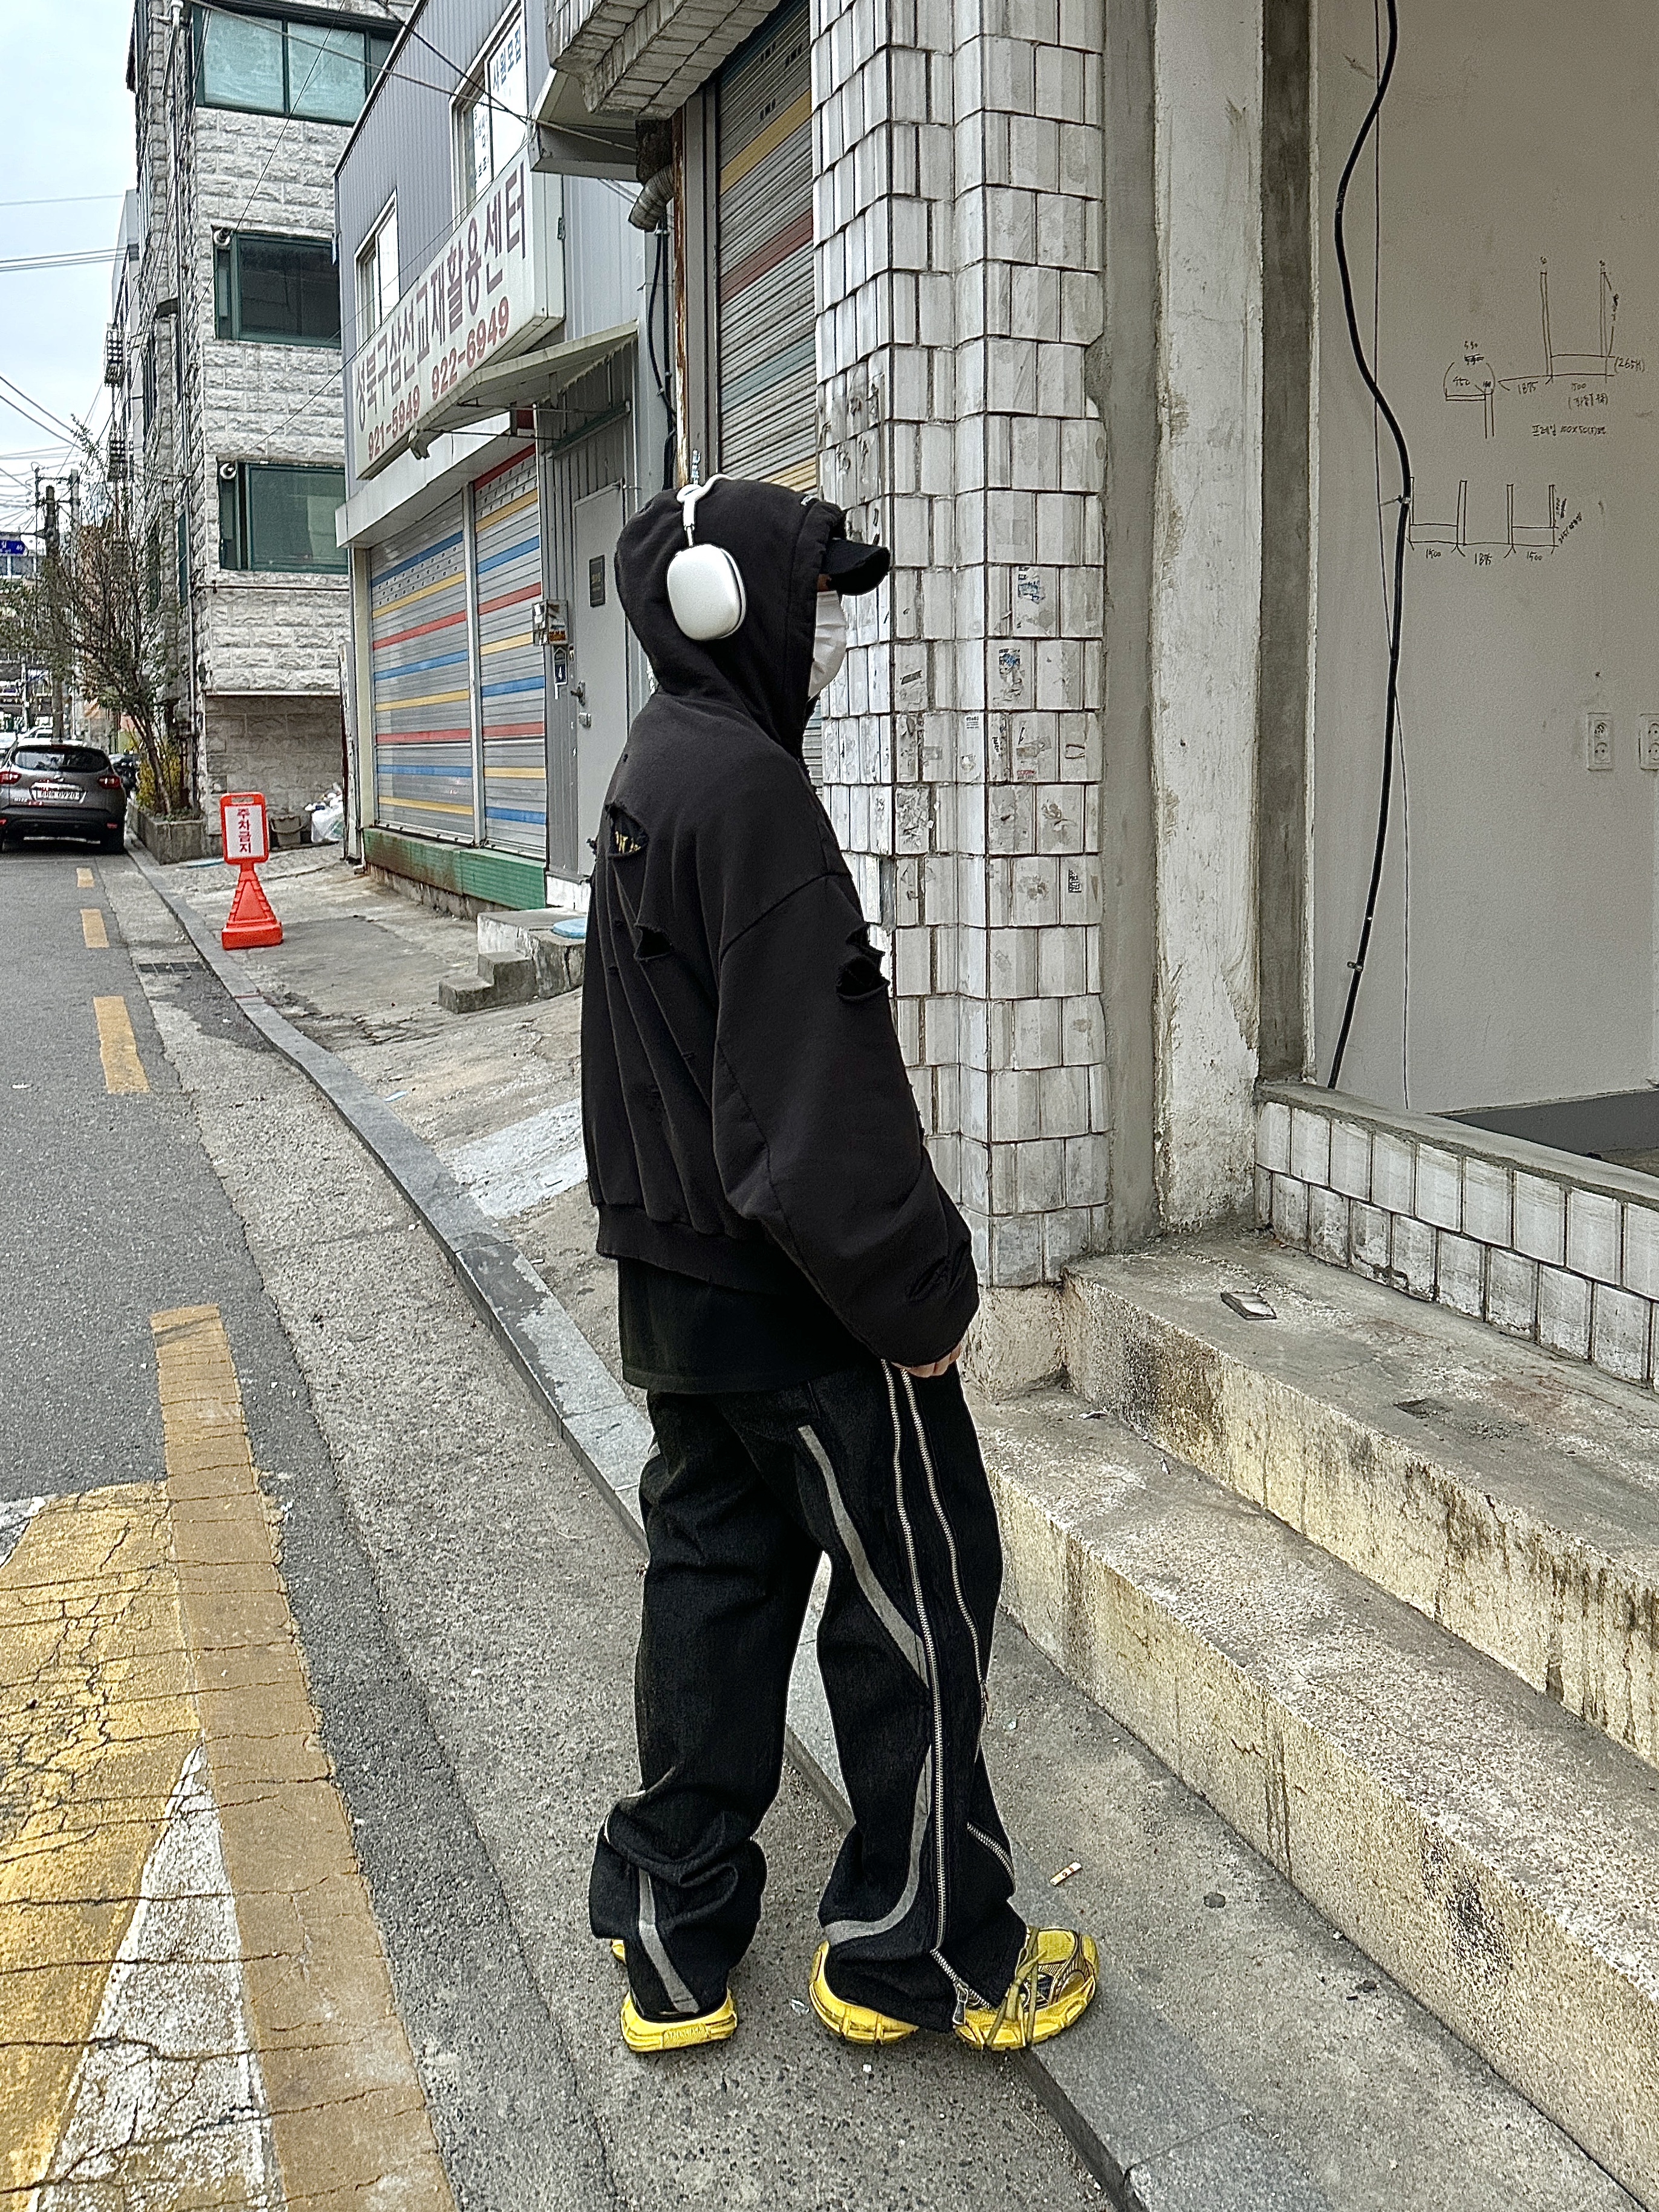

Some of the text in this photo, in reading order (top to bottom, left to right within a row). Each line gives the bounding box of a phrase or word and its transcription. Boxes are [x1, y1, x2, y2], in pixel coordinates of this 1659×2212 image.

[493, 24, 521, 92] 사원모집
[368, 296, 509, 461] 921-5949 922-6949
[236, 808, 252, 854] 주차금지
